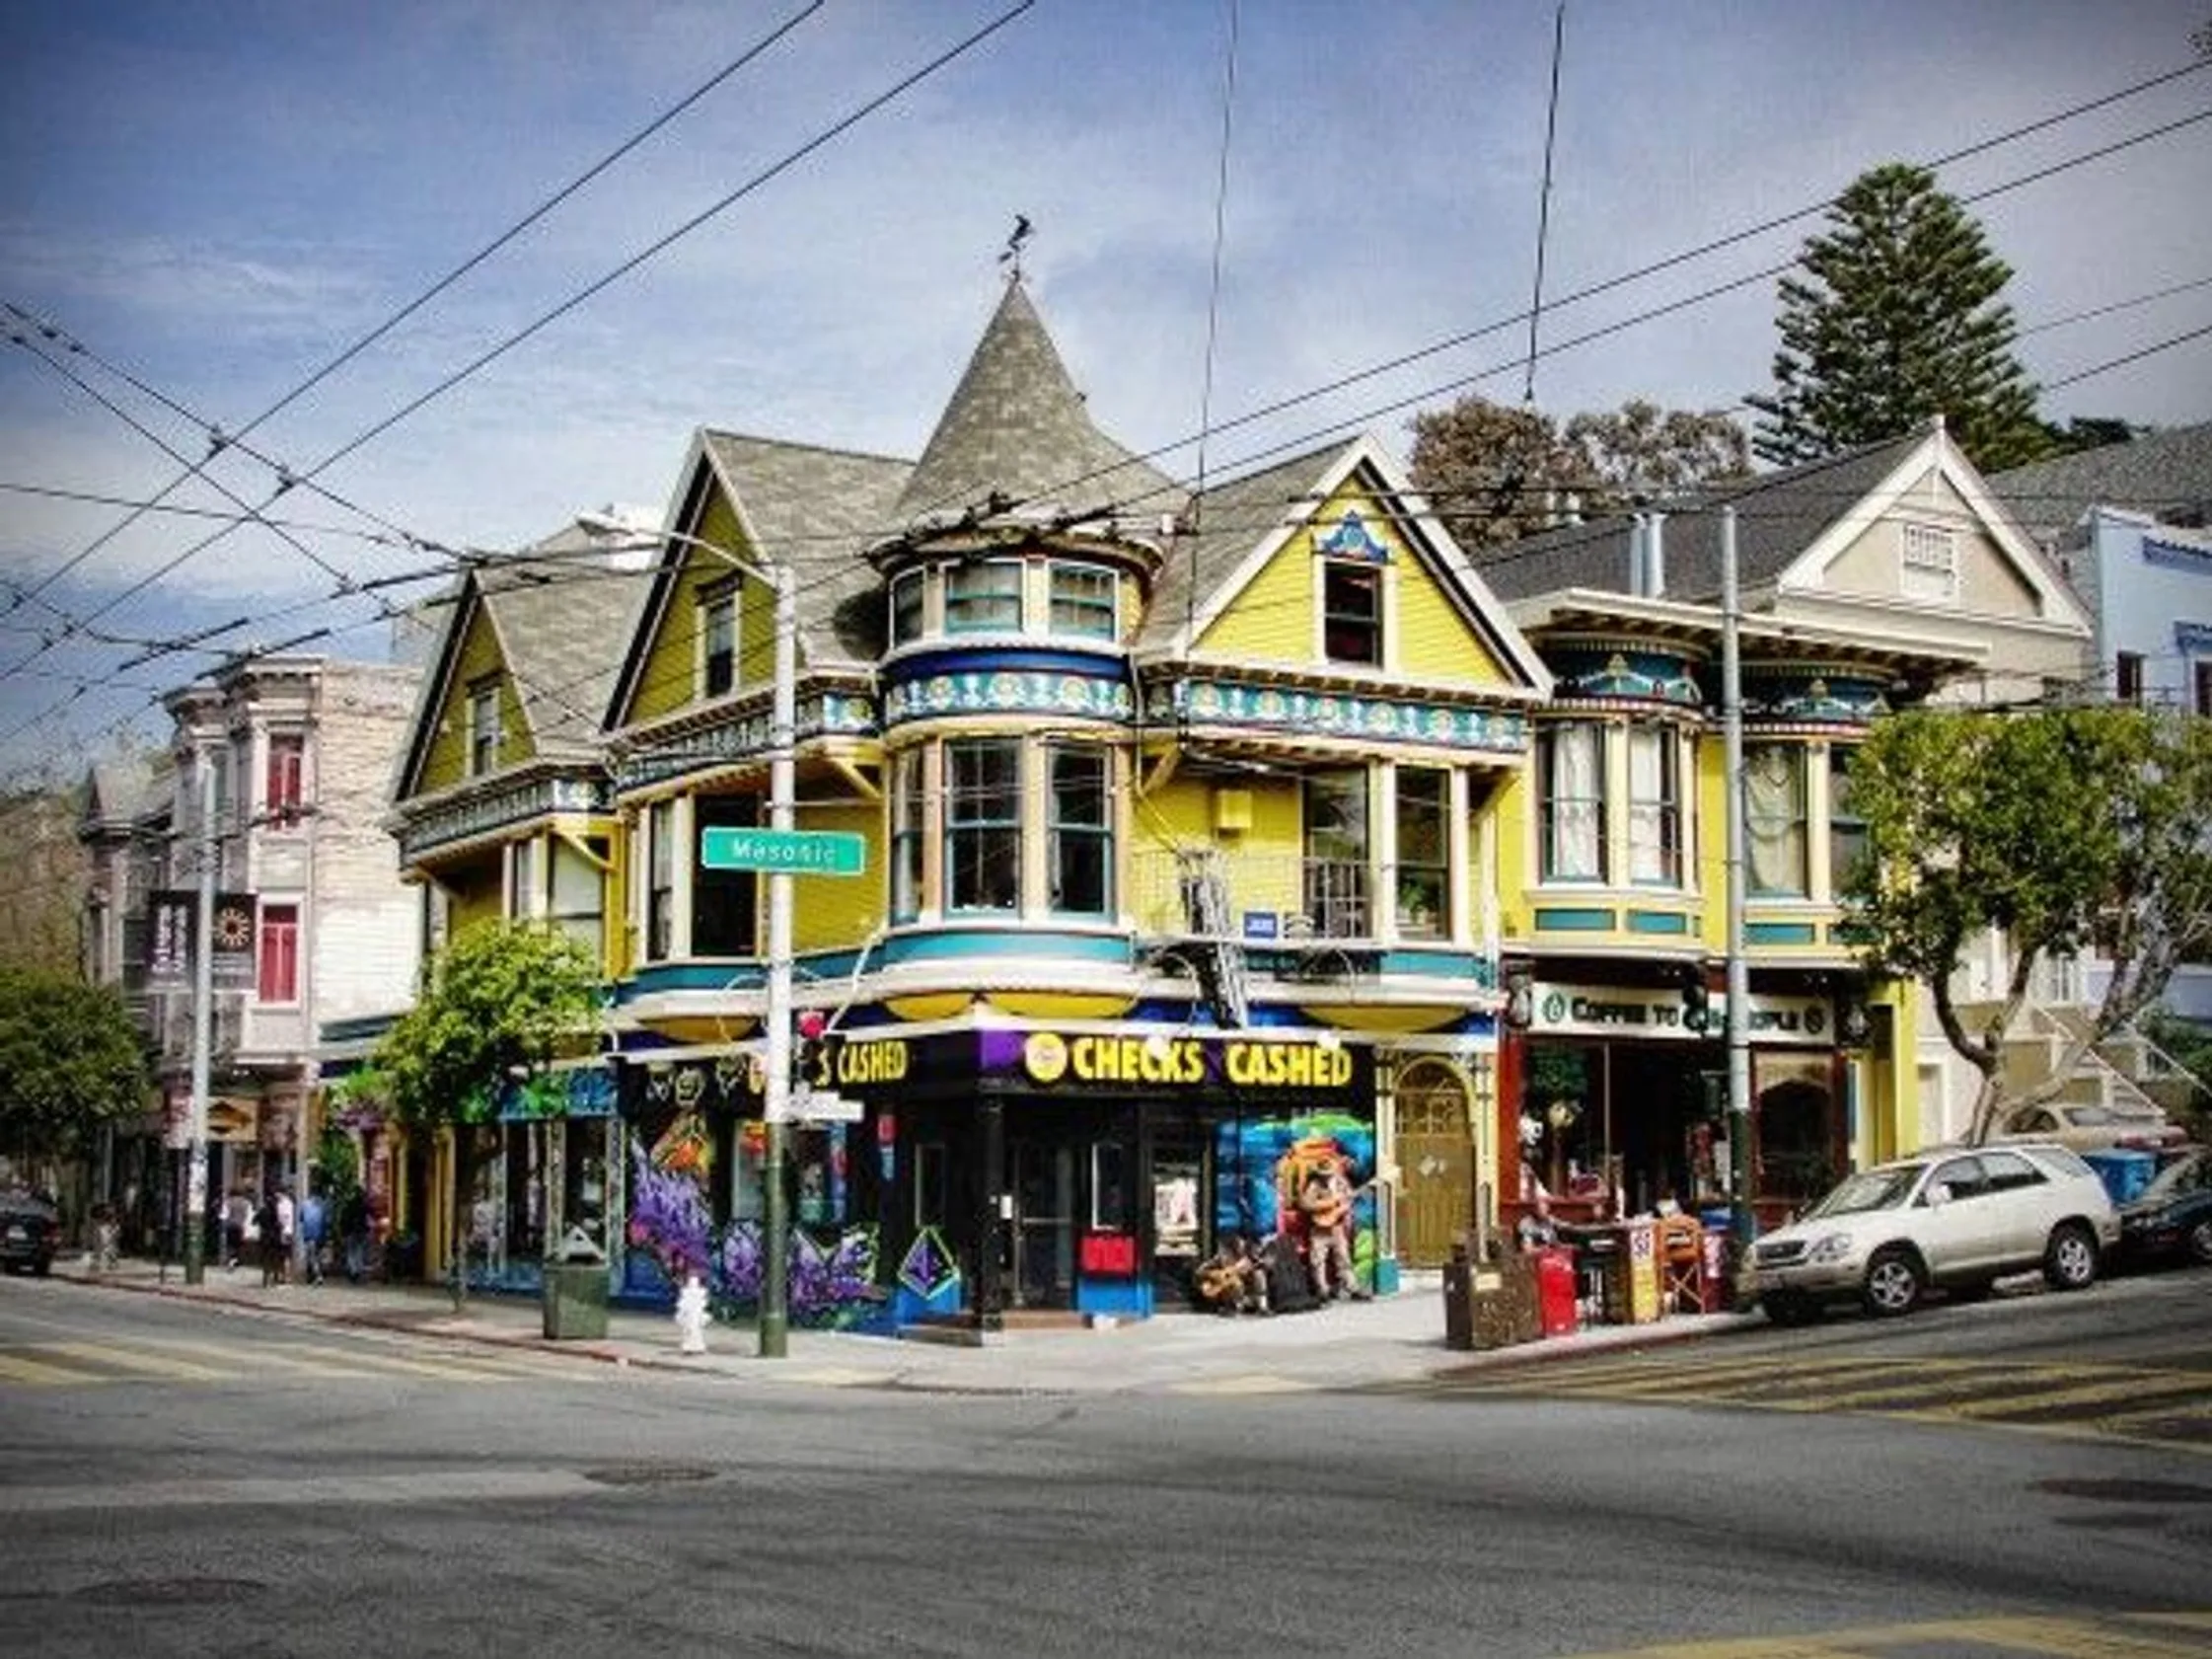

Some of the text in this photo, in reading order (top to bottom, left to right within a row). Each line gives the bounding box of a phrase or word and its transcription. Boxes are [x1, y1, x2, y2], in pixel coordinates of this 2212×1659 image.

[733, 837, 837, 863] Masonic
[839, 1040, 907, 1083] CASHED
[1073, 1037, 1353, 1086] CHECKS CASHED
